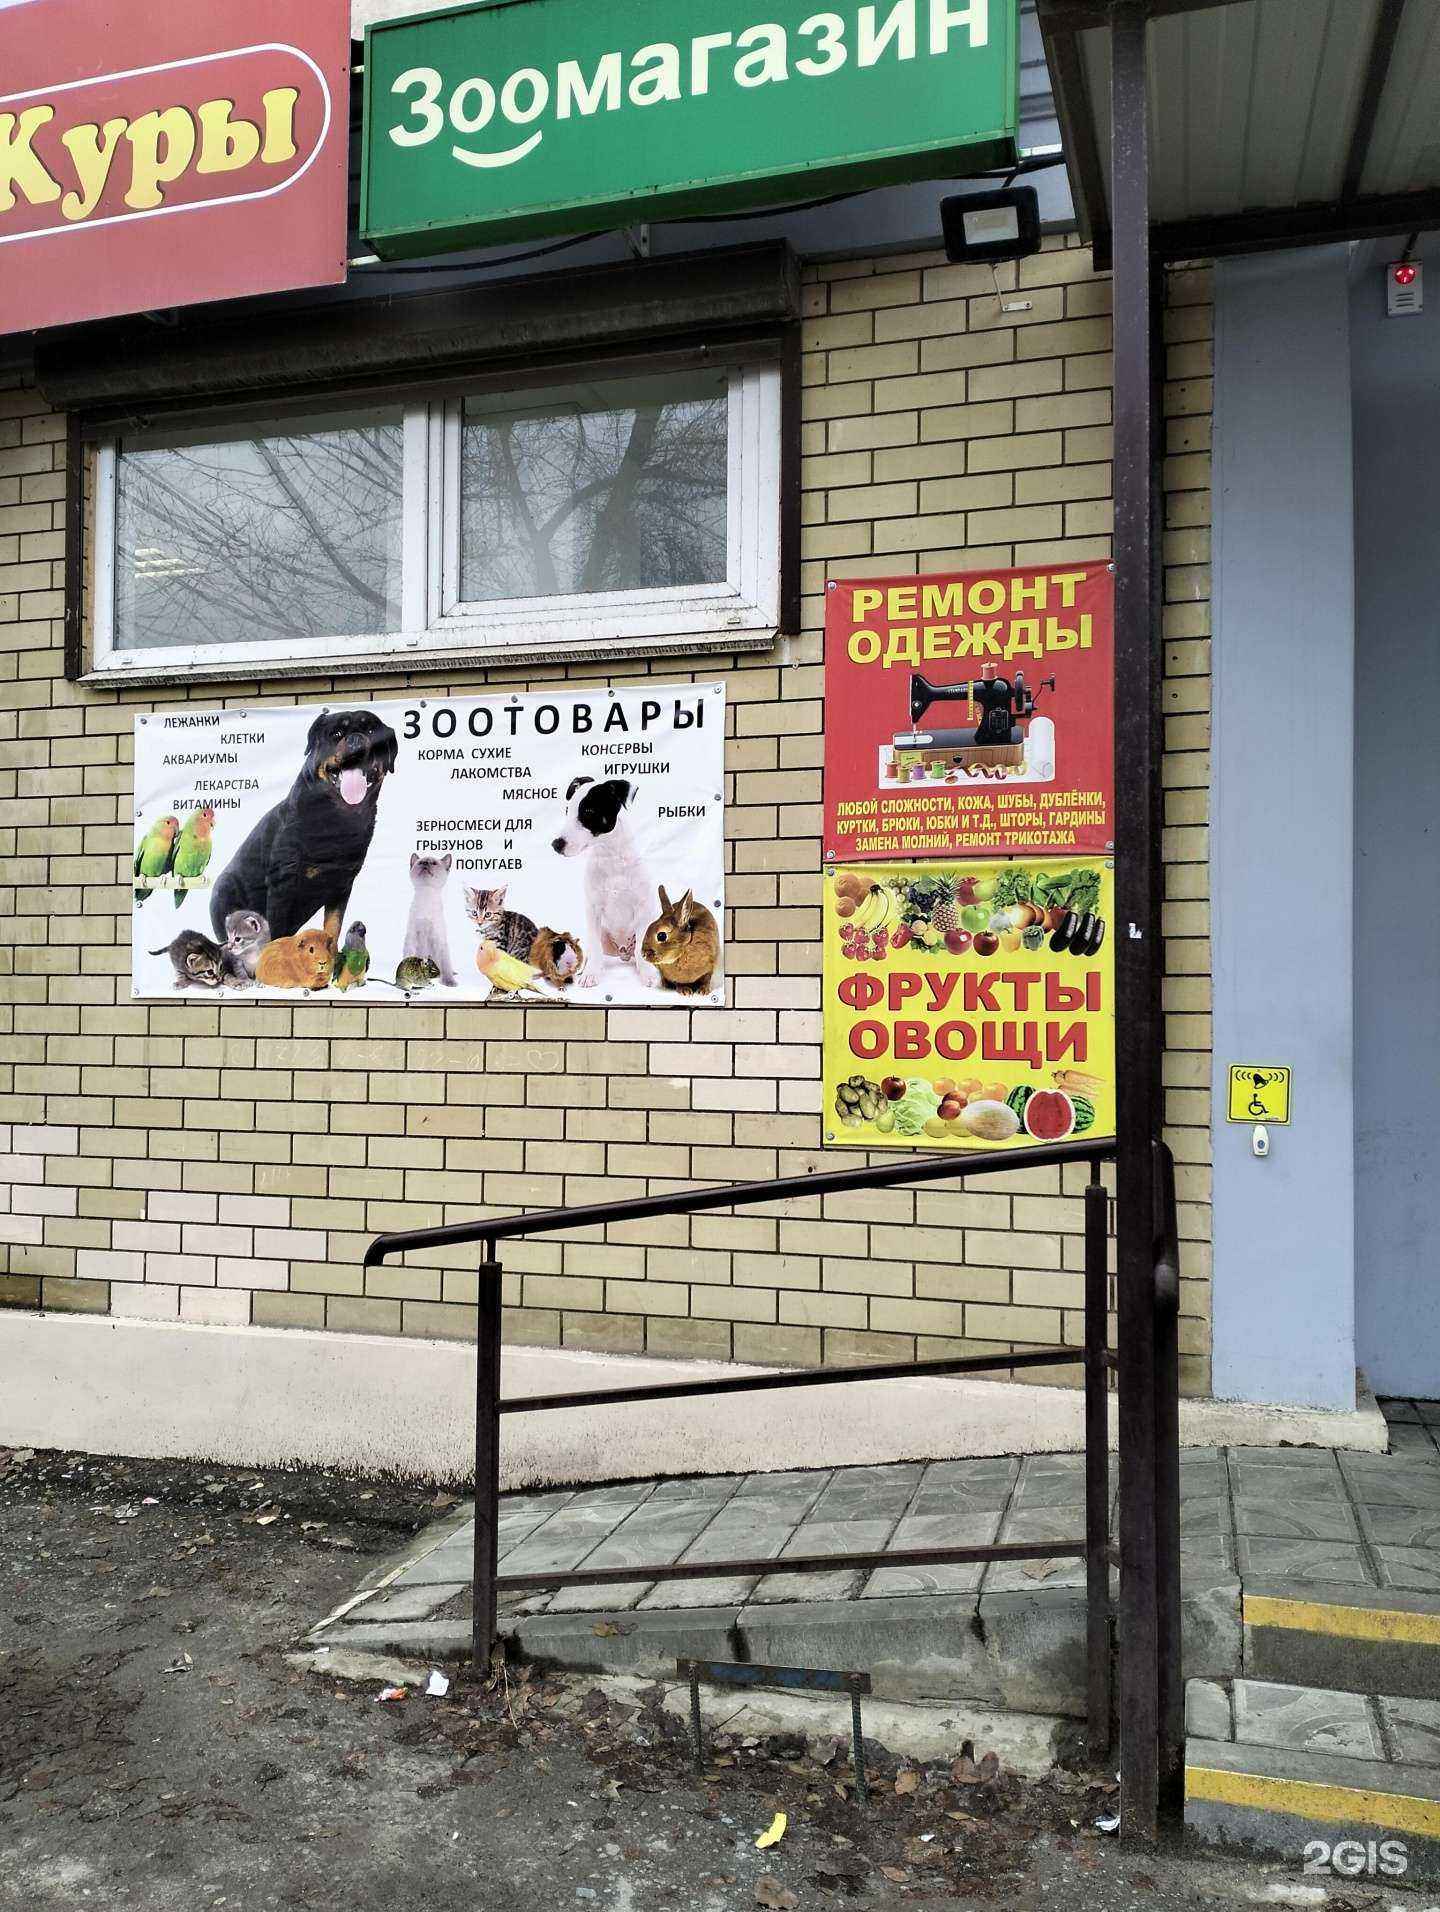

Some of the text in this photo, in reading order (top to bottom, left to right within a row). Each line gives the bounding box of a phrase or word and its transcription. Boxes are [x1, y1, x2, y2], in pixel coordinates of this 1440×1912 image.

[388, 0, 989, 148] Зоомагазин
[852, 572, 1087, 623] РЕМОНТ
[847, 614, 1093, 669] ОДЕЖДЫ
[163, 715, 220, 729] ЛЕЖАНКИ
[403, 698, 704, 740] ЗООТОВАРЫ
[220, 732, 265, 745] КЛЕТКИ
[418, 747, 512, 761] КОРМА СУХИЕ
[581, 742, 653, 756] КОНСЕРВЫ
[163, 752, 238, 766] АКВАРИУМЫ
[450, 766, 532, 780] ЛАКОМСТВА
[604, 761, 671, 776] ИГРУШКИ
[194, 779, 260, 792] ЛЕКАРСТВА
[502, 787, 558, 800] МЯСНОЕ
[173, 797, 241, 810] ВИТАМИНЫ
[837, 789, 1106, 816] ЛЮБОЙ СЛОЖНОСТИ, КОЖА, ШУБЫ, ДУБЛЁНКИ,
[658, 805, 706, 818] РЫБКИ
[416, 818, 532, 833] ЗЕРНОСМЕСИ ДЛЯ
[837, 819, 879, 835] КУРТКИ,
[882, 817, 923, 832] БРЮКИ,
[926, 814, 959, 830] ЮБКИ
[961, 814, 970, 829] И
[1000, 812, 1046, 829] ШТОРЫ,
[1049, 810, 1106, 828] ГАРДИНЫ
[416, 838, 513, 851] ГРЫЗУНОВ И
[855, 830, 1076, 852] ЗАМЕНА МОЛНИЙ, РЕМОНТ ТРИКОТАЖА
[456, 858, 523, 870] ПОПУГАЕВ
[837, 971, 1101, 1012] ФРУКТЫ
[848, 1020, 1088, 1070] ОВОЩИ
